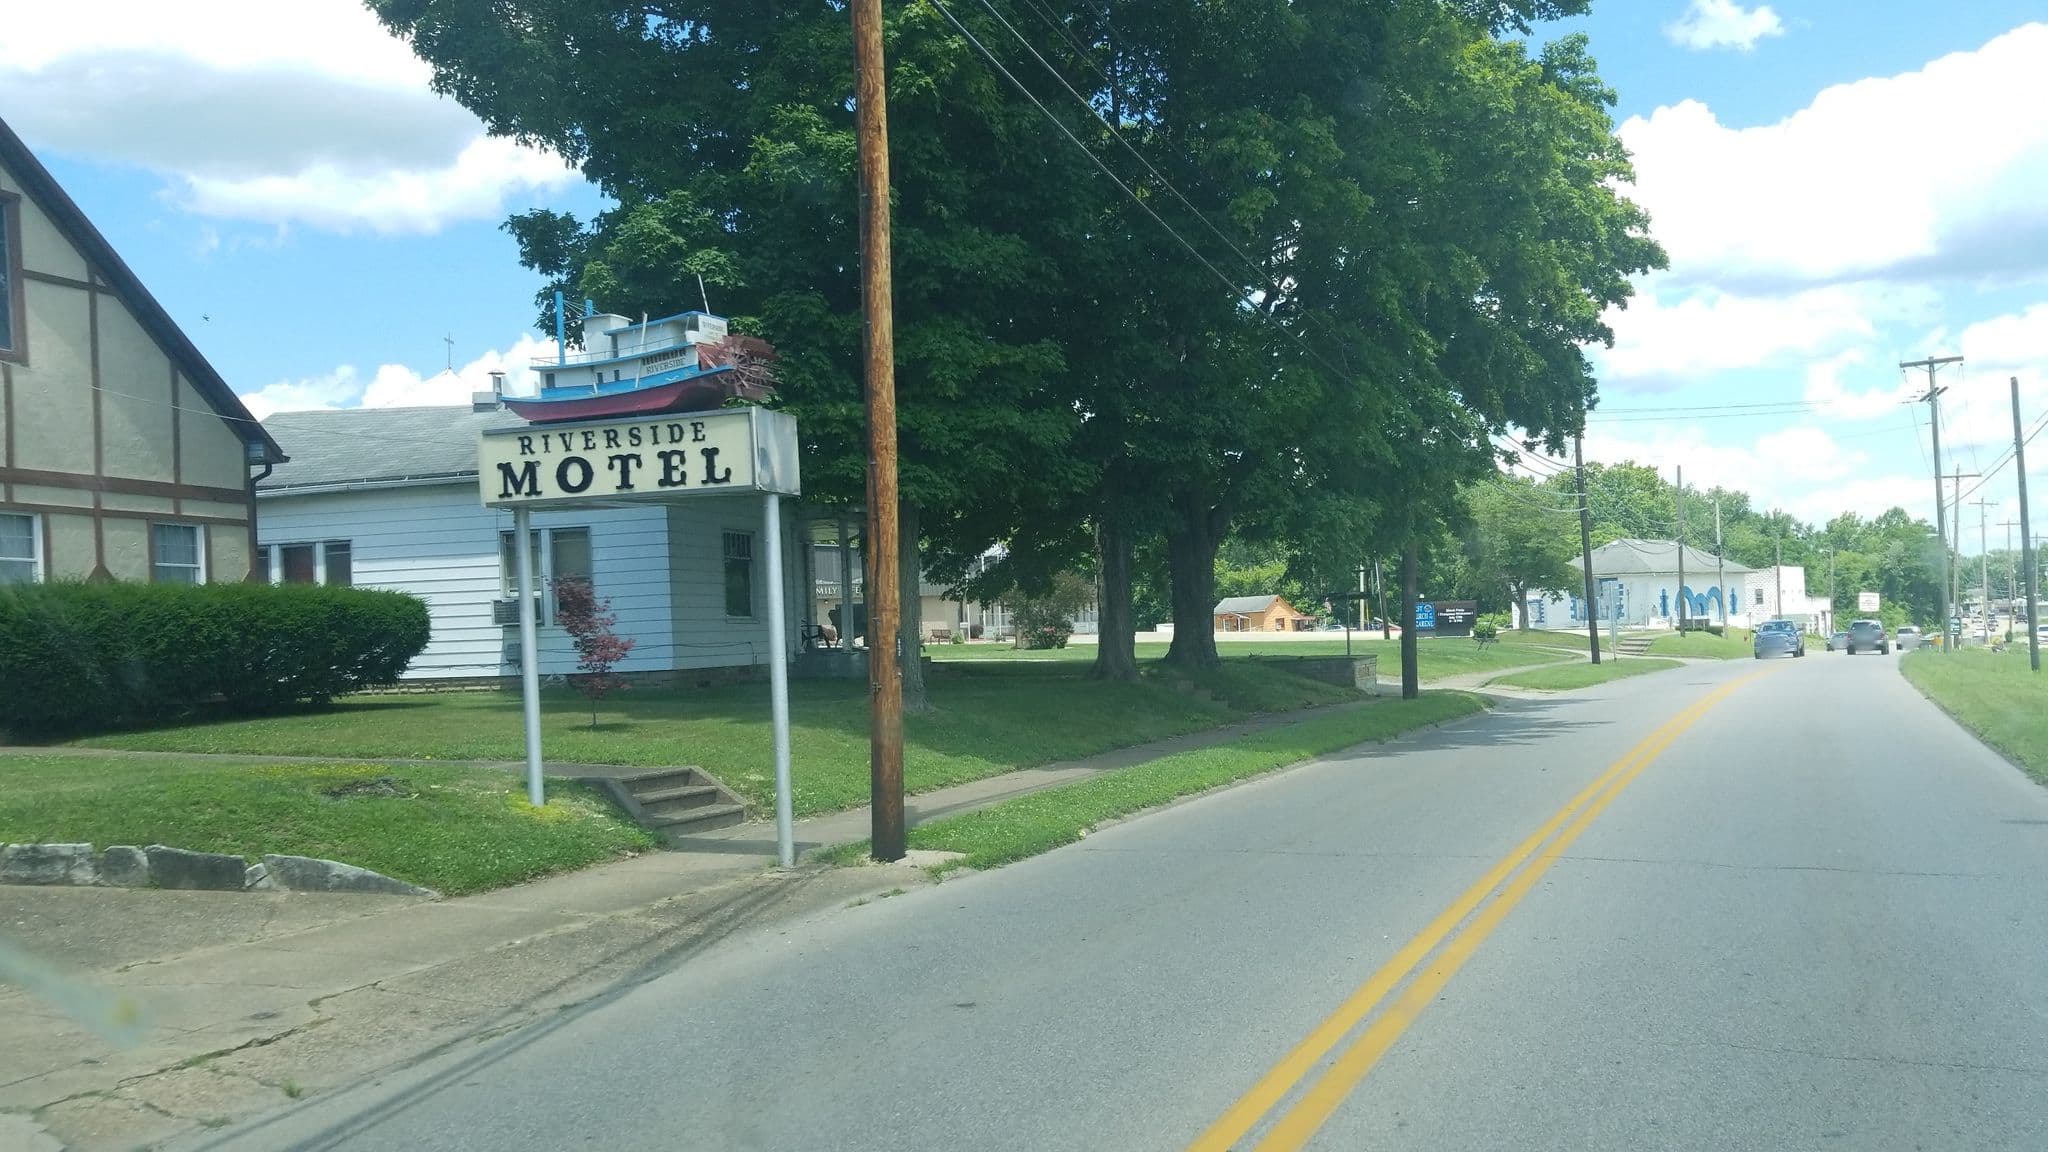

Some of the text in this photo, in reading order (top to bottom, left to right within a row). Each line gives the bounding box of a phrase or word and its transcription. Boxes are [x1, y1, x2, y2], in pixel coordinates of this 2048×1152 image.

[646, 357, 686, 374] RIVERSIDE
[517, 421, 706, 455] RIVERSIDE
[496, 447, 732, 499] MOTEL
[816, 586, 837, 594] MILY
